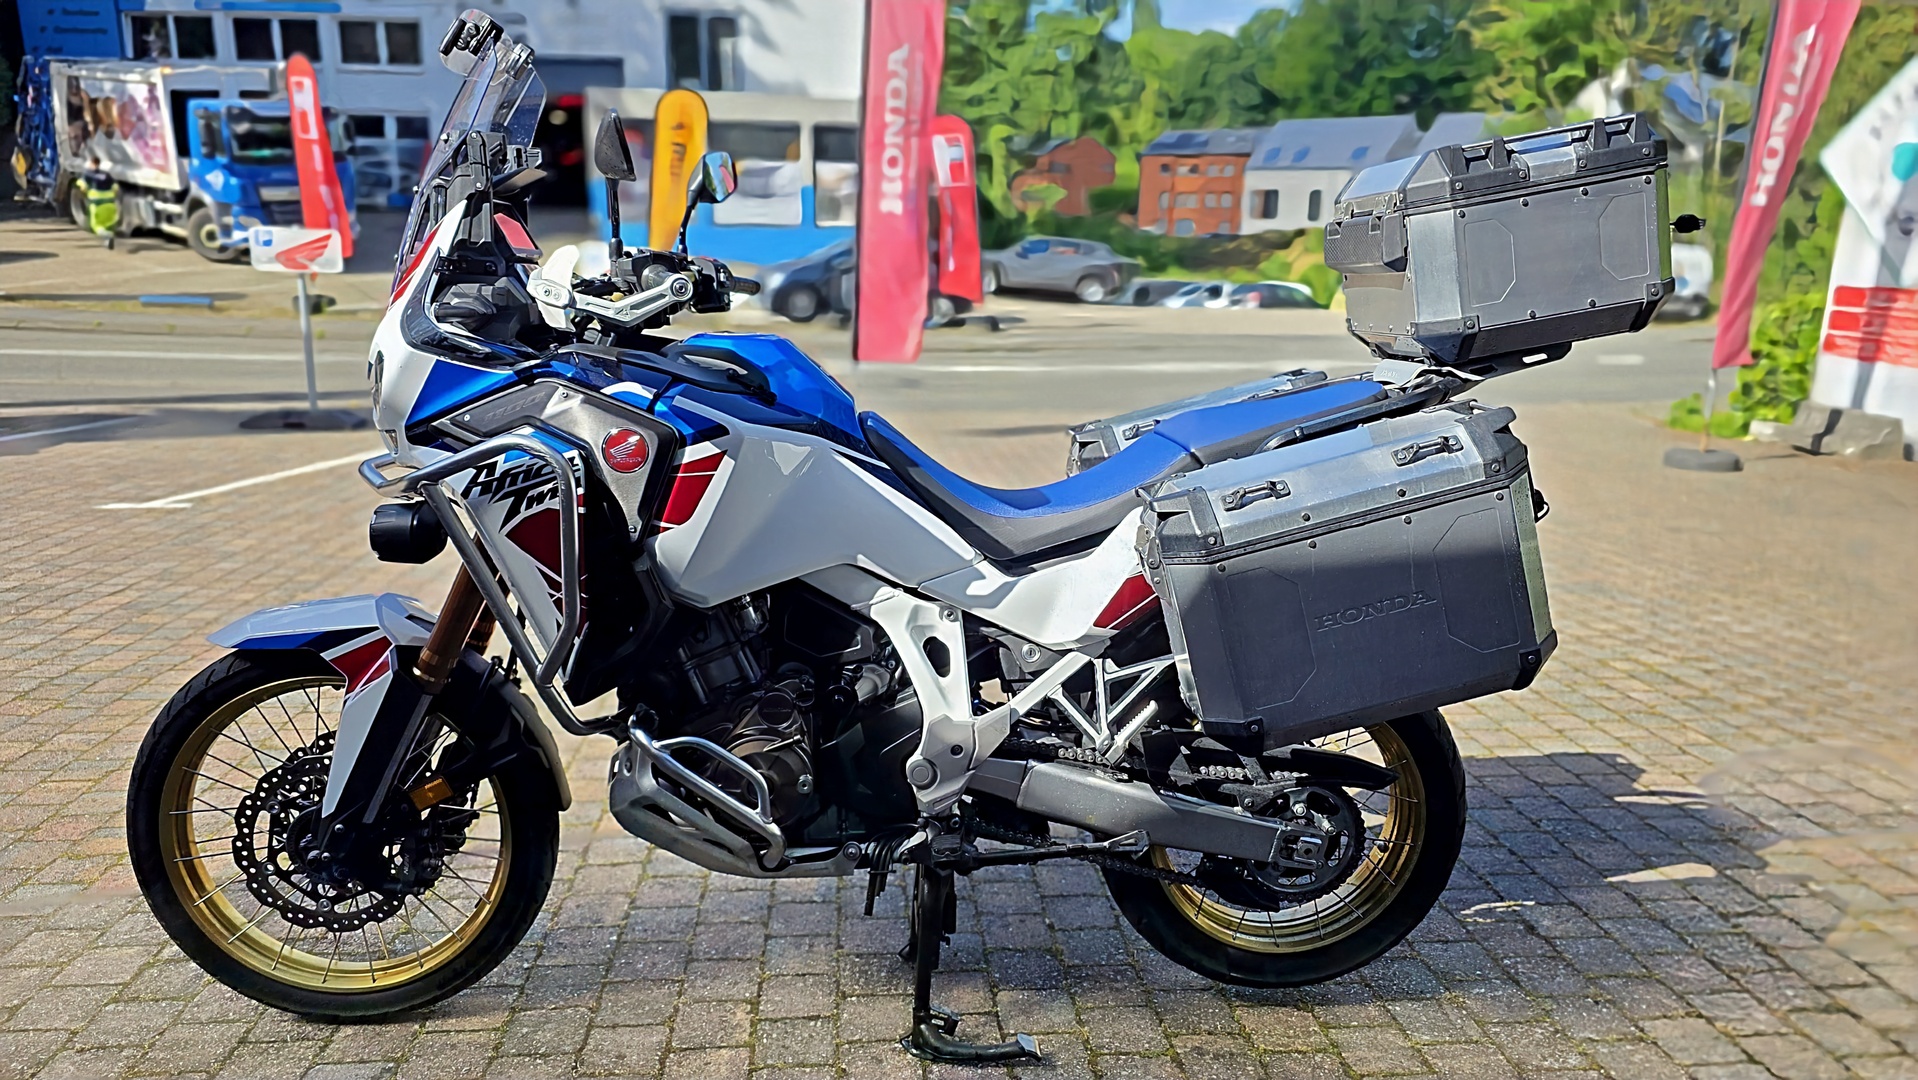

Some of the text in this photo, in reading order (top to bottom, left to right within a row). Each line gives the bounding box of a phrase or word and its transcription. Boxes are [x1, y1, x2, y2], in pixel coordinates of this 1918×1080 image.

[879, 43, 910, 215] HONDA
[460, 455, 581, 504] Afric
[492, 475, 581, 534] Twi
[1314, 590, 1437, 632] HONDA
